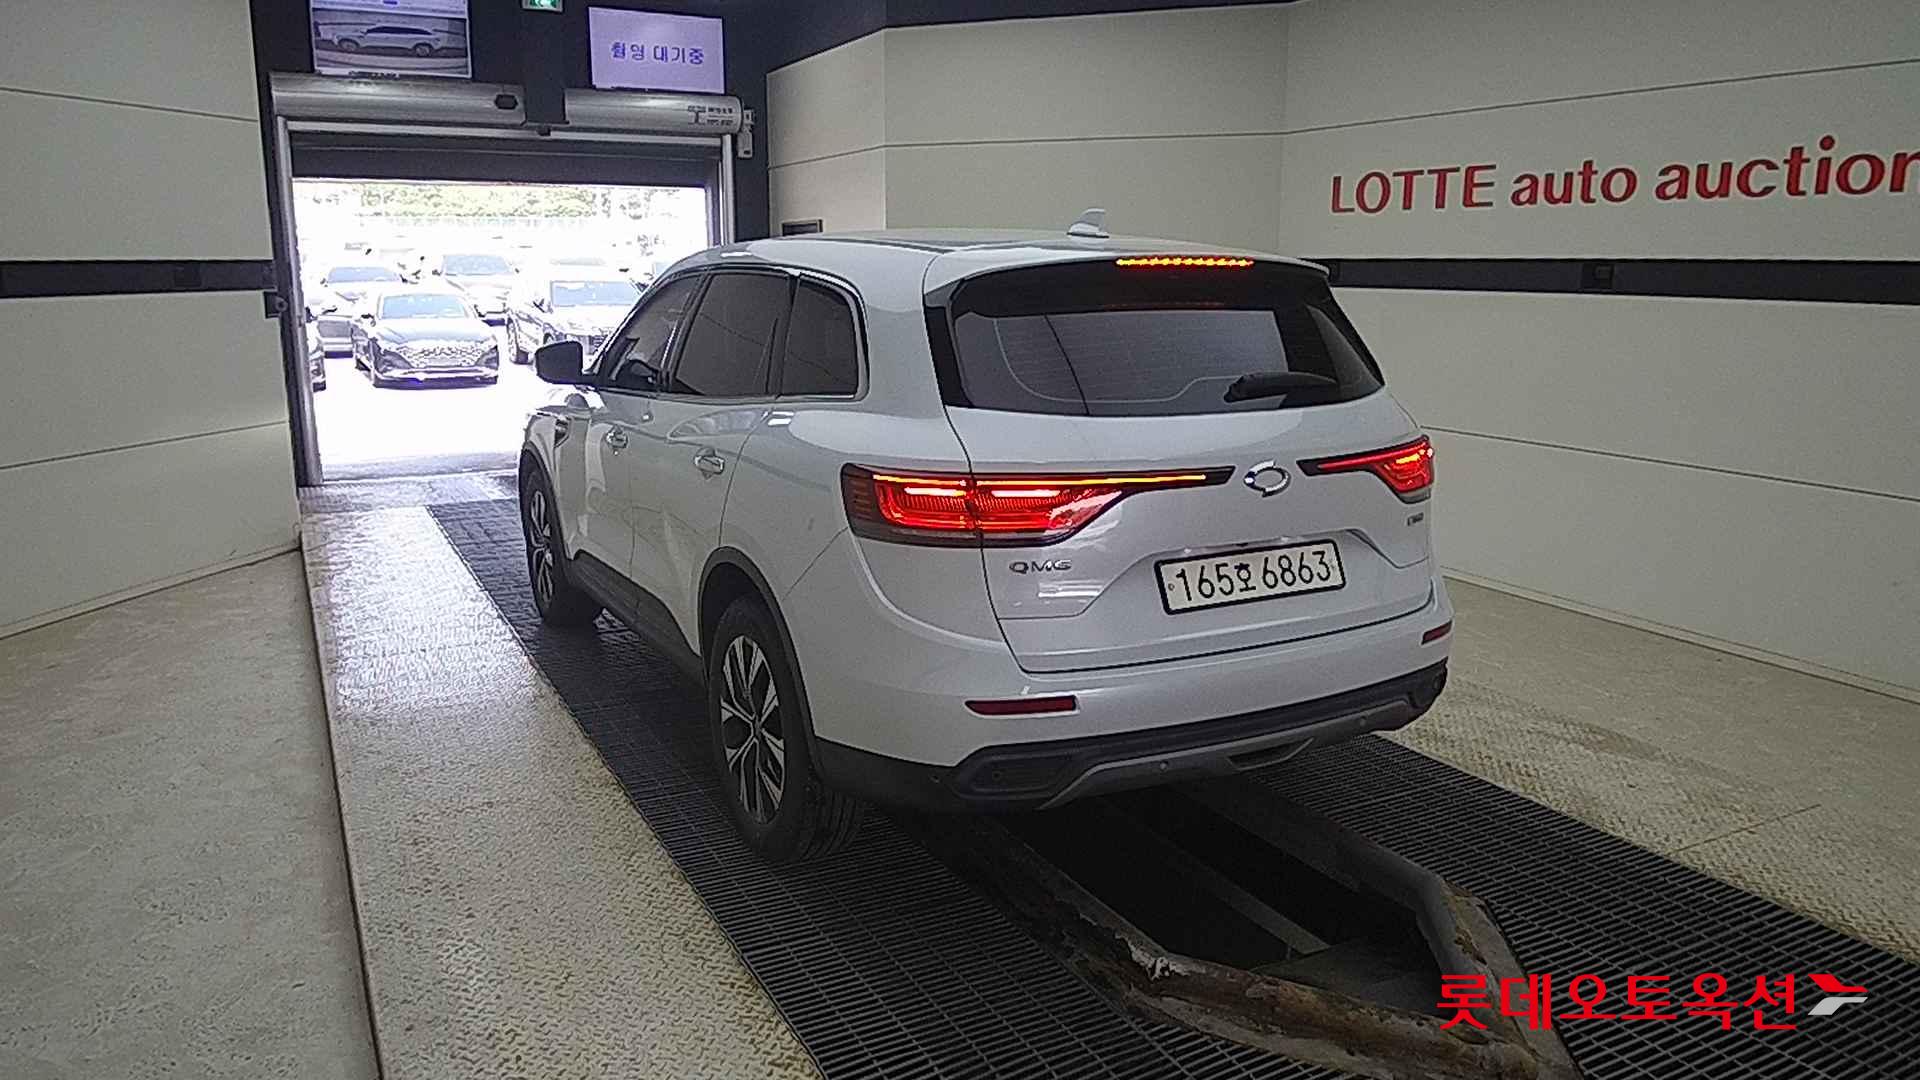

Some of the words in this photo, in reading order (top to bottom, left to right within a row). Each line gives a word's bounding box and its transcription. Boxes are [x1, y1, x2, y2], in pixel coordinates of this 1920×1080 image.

[653, 46, 704, 65] 대기중
[1331, 164, 1497, 213] LOTTE
[1511, 160, 1637, 207] auto
[1655, 135, 1920, 200] auction
